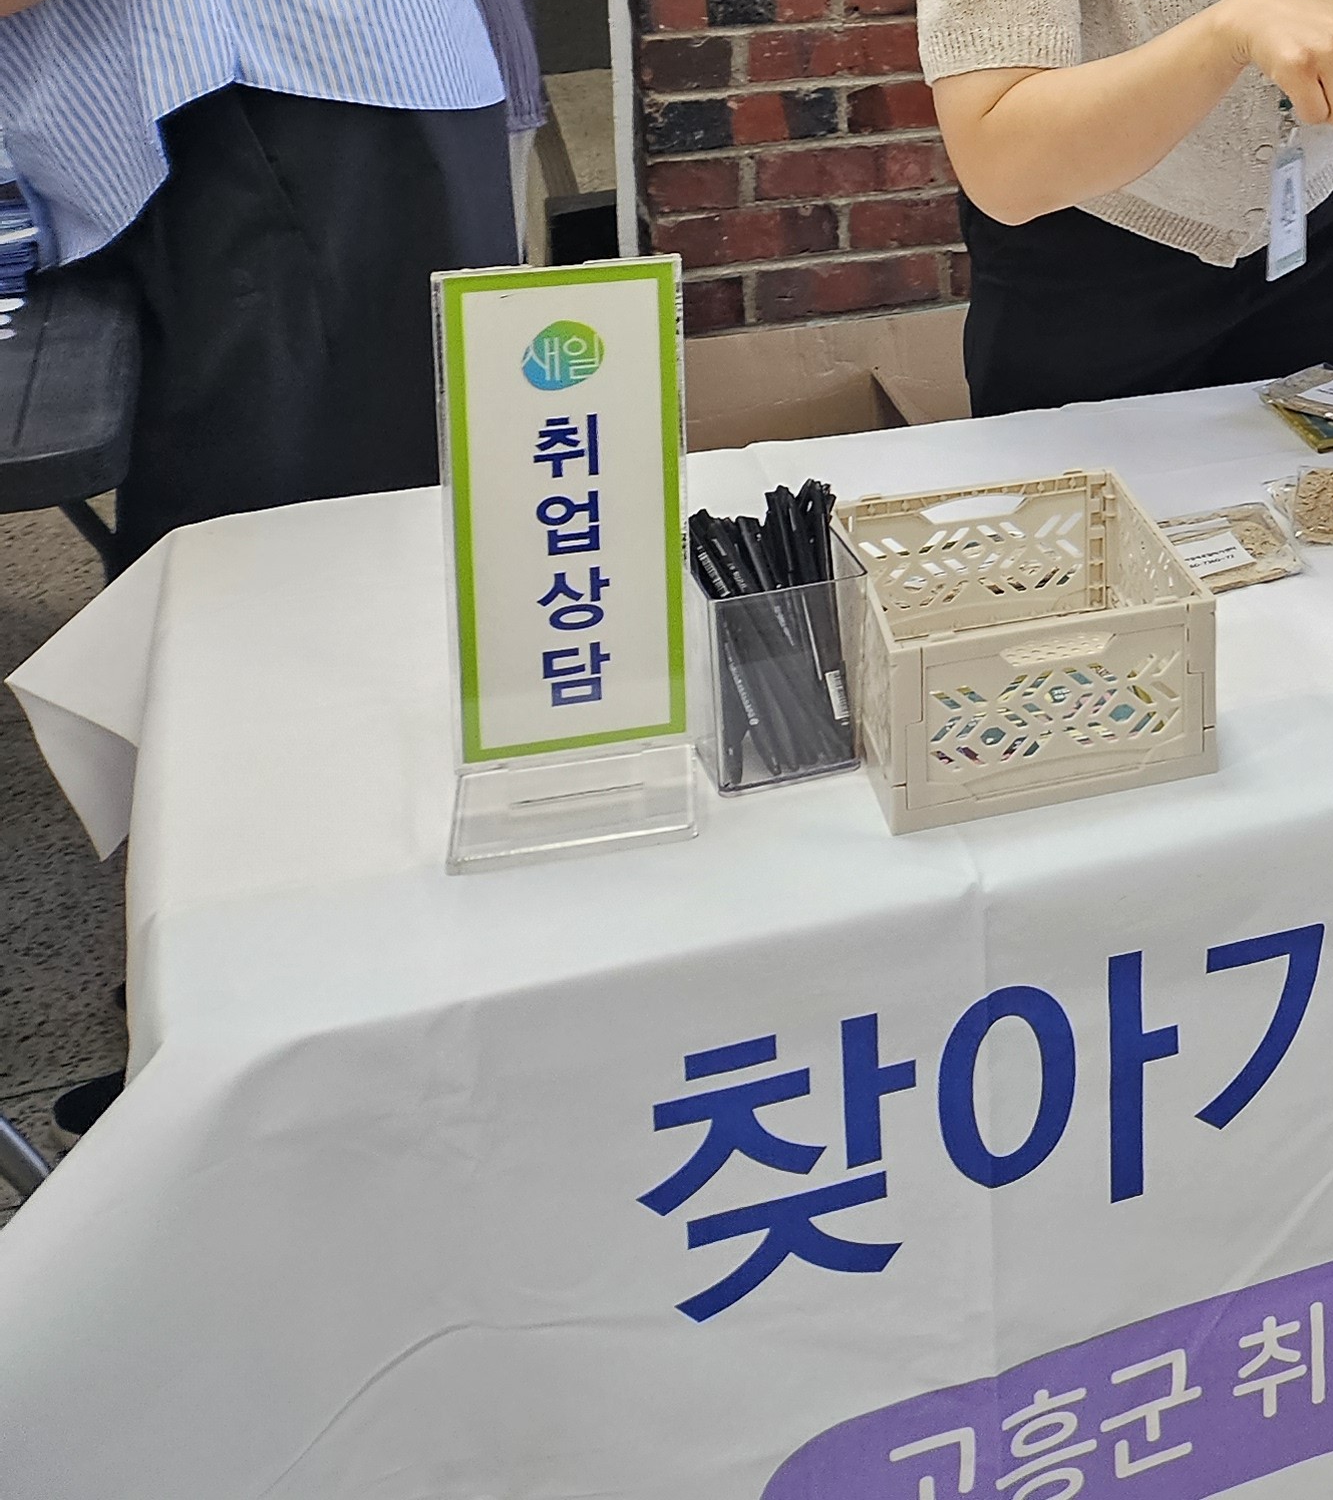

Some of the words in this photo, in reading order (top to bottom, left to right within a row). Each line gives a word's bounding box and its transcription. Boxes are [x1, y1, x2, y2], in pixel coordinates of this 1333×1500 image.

[521, 332, 601, 381] 새일
[532, 412, 611, 708] 취업상담
[888, 1347, 1203, 1500] 고흥군
